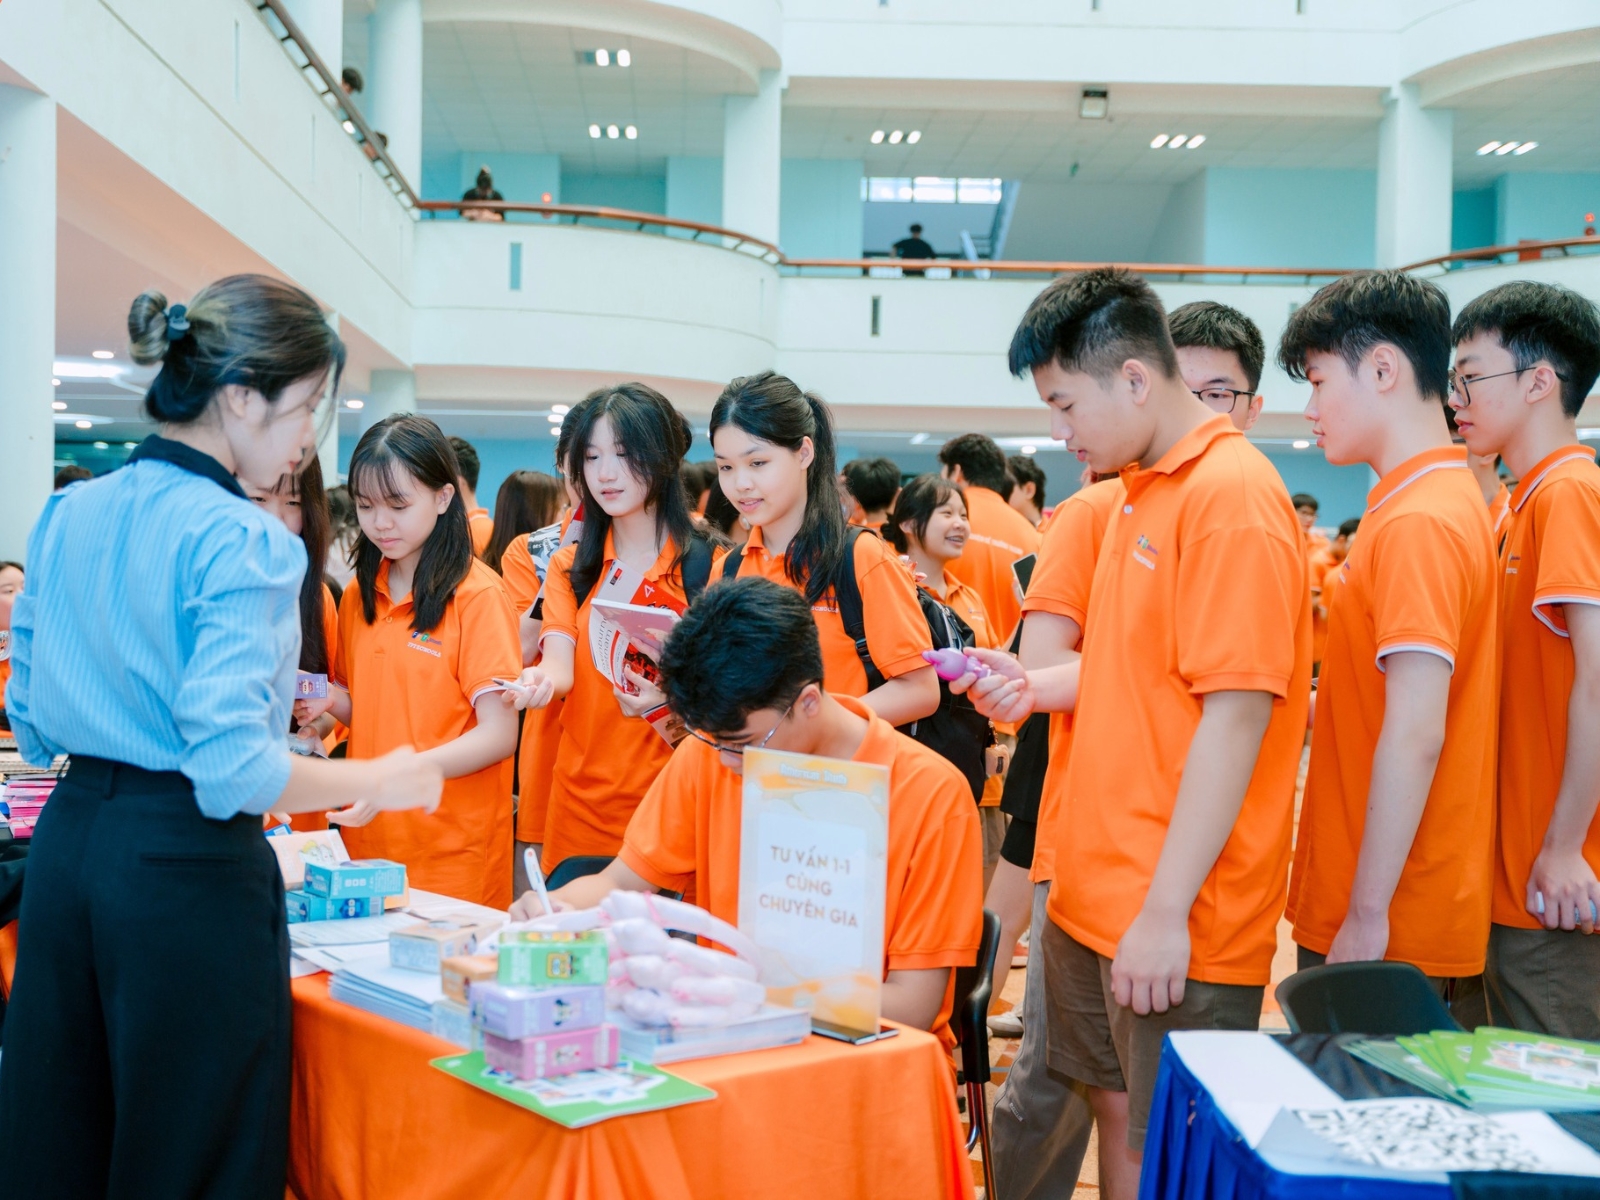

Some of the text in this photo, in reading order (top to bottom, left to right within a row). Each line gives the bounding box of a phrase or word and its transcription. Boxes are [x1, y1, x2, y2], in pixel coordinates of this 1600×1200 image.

[833, 857, 850, 875] 1-1
[785, 871, 832, 896] CÙNG
[759, 893, 859, 928] CHUYÊN GIA
